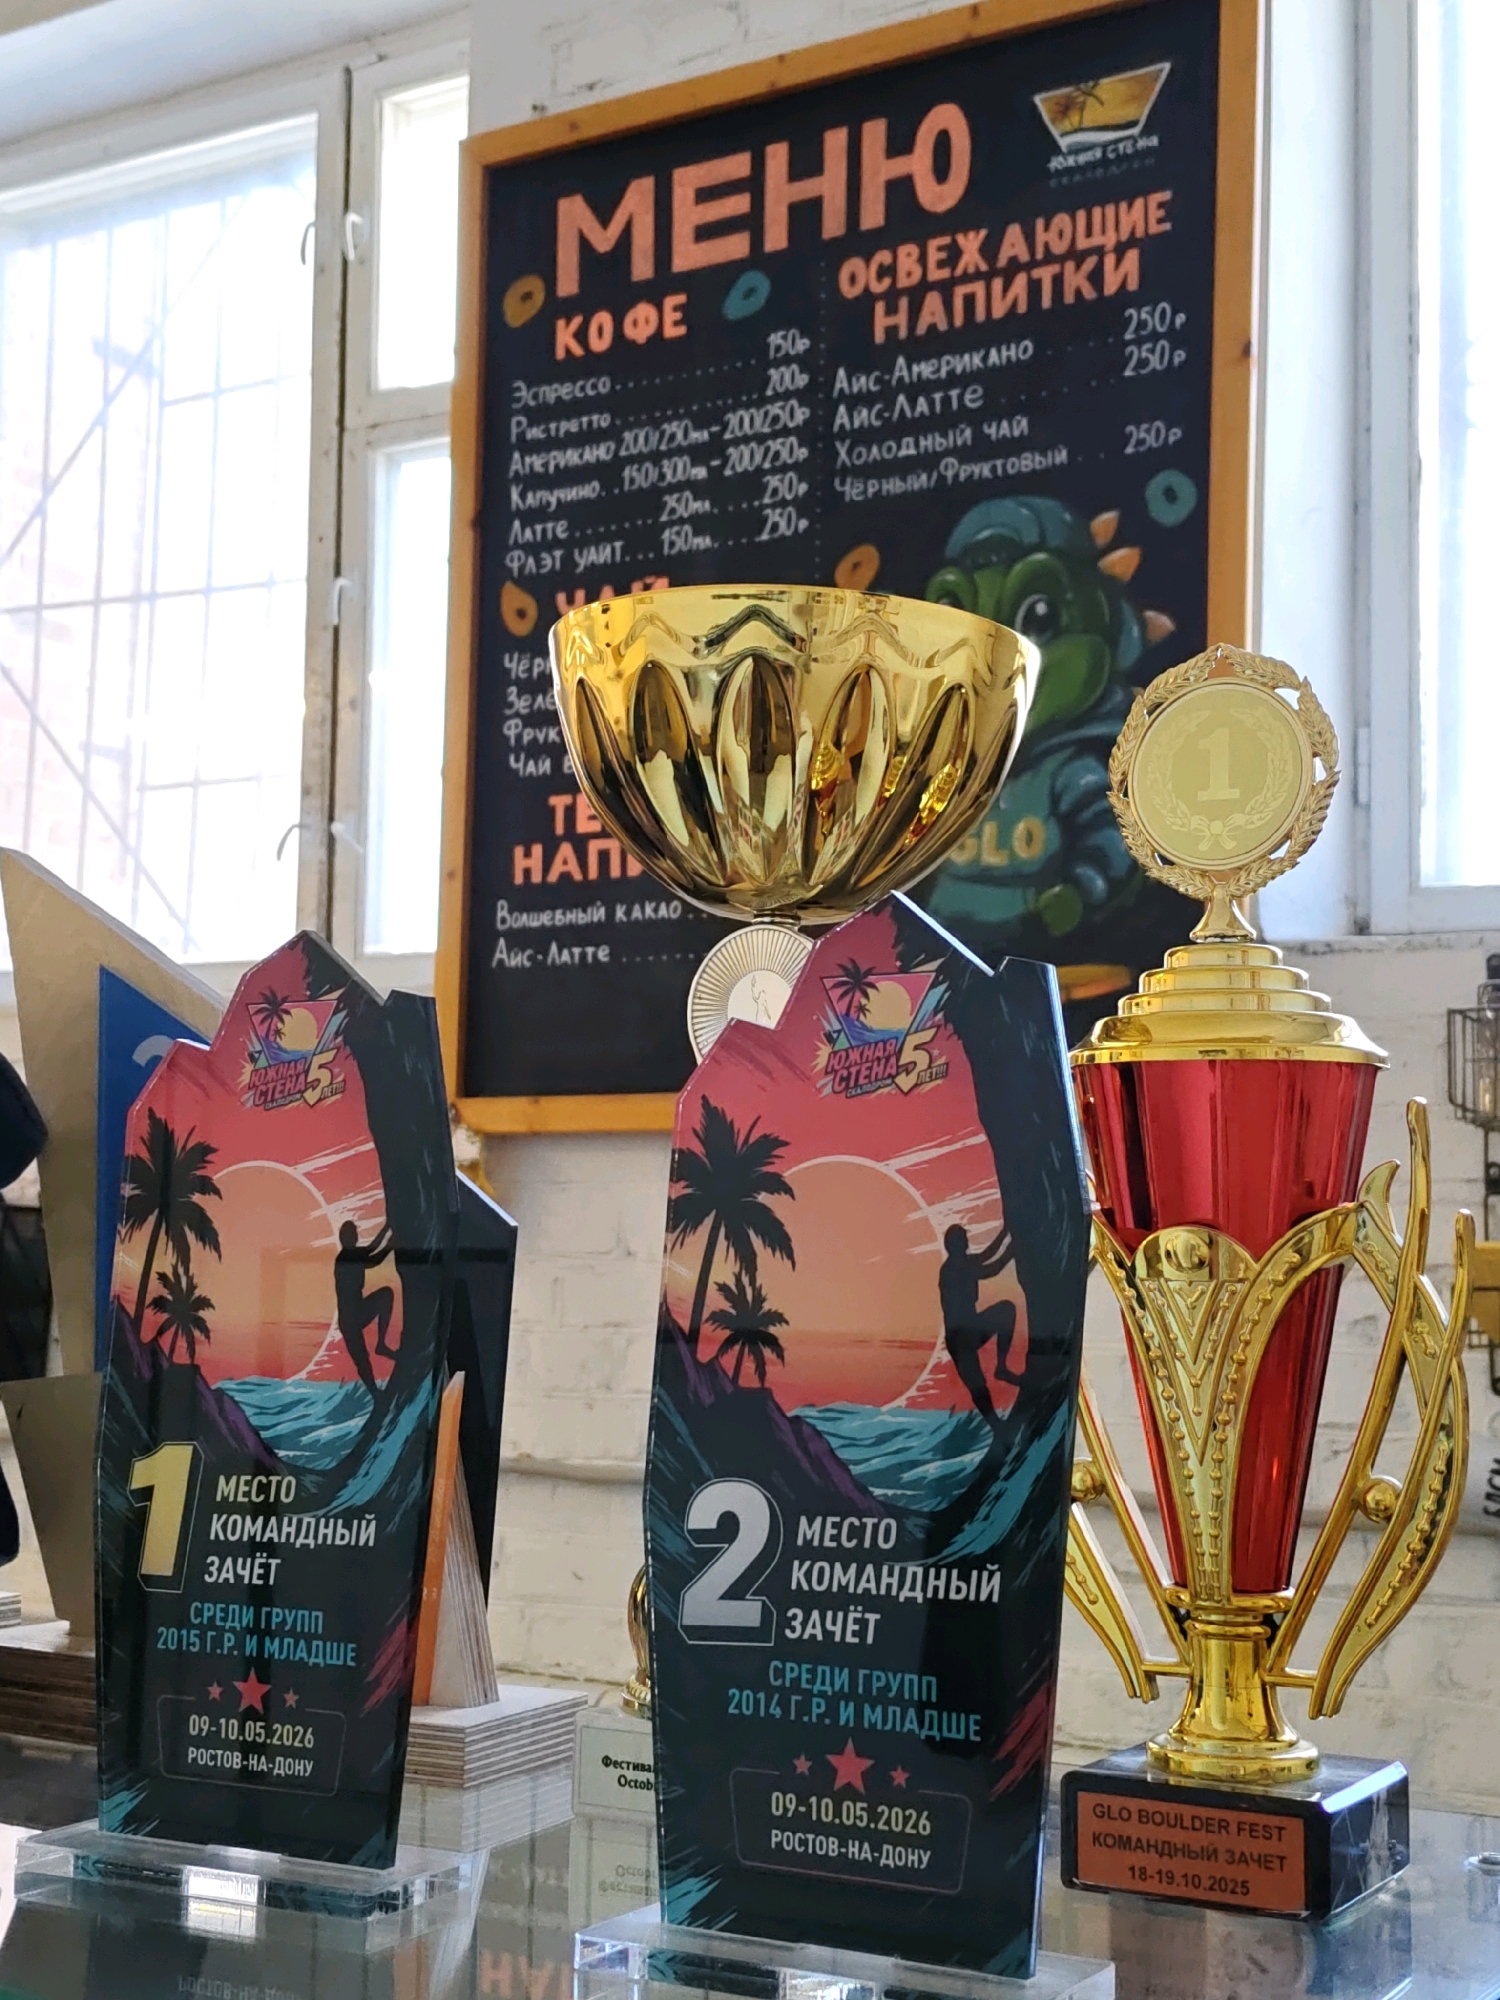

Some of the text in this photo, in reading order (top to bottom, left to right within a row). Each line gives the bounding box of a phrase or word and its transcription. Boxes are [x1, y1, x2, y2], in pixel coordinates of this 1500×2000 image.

[556, 103, 971, 298] МЕНЮ
[838, 189, 1173, 299] ОСВЕЖАЮЩИЕ
[874, 246, 1141, 345] НАПИТКИ
[554, 293, 688, 361] КОФЕ
[508, 518, 570, 546] Латте
[1197, 727, 1241, 801] 1
[249, 1058, 307, 1089] ЮЖНАЯ
[826, 1038, 898, 1073] ЮЖНАЯ
[832, 1055, 898, 1093] СТЕНА
[894, 1026, 939, 1094] 5
[254, 1072, 307, 1106] СТЕНА
[302, 1048, 338, 1107] 5
[129, 1443, 297, 1577] 1 МЕСТО
[209, 1513, 377, 1549] КОМАНДНЫЙ
[203, 1552, 281, 1586] ЗАЧЁТ
[681, 1480, 898, 1628] 2 МЕСТО
[790, 1559, 1001, 1604] КОМАНДНЫЙ
[189, 1601, 324, 1635] СРЕДИ ГРУПП
[784, 1605, 882, 1645] ЗАЧЁТ
[156, 1626, 358, 1667] 2015 Г.Р. И МЛАДШЕ
[768, 1660, 938, 1703] СРЕДИ ГРУПП
[188, 1714, 315, 1749] 09-10.05.2026
[727, 1688, 983, 1742] 2014 Г.Р. И МЛАДШЕ
[187, 1746, 314, 1778] РОСТОВ-НА-ДОНУ
[601, 1754, 654, 1774] Фестива
[770, 1790, 932, 1836] 09-10.05.2026
[1092, 1802, 1287, 1843] GLO BOULDER FEST
[770, 1829, 932, 1870] РОСТОВ-НА-ДОНУ
[1091, 1831, 1288, 1873] КОМАНДНЫЙ ЗАЧЕТ
[1128, 1864, 1250, 1897] 18-19.10.2025
